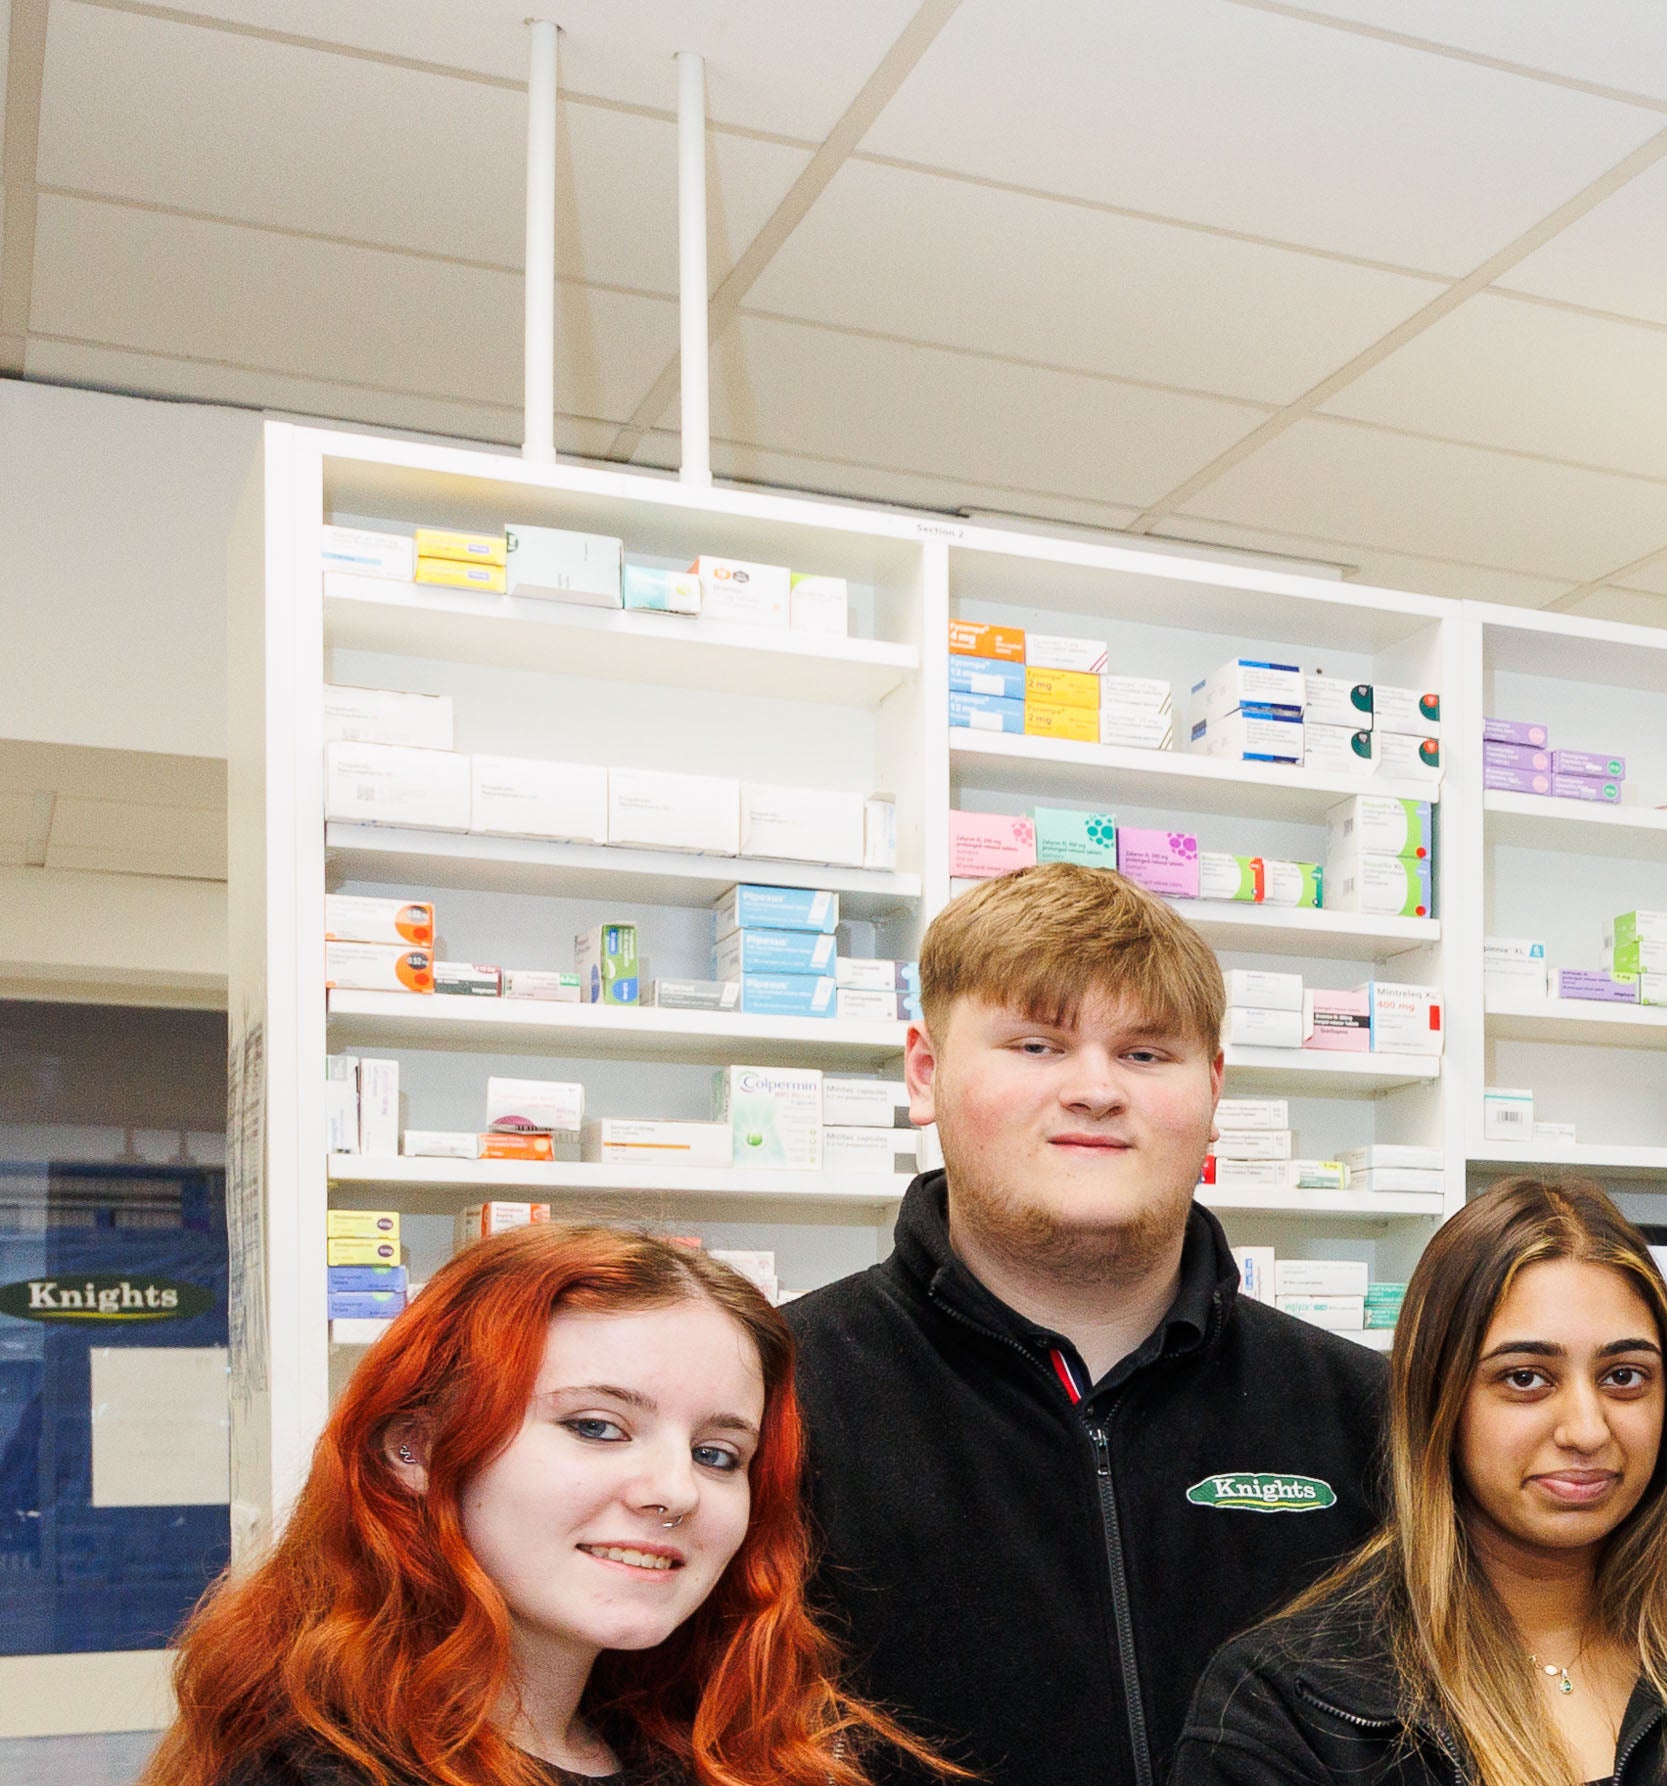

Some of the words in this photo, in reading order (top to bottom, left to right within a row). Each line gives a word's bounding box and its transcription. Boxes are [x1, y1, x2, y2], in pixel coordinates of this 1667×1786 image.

[917, 524, 955, 537] Section
[958, 530, 965, 538] 2
[1035, 682, 1052, 691] mg
[1035, 716, 1052, 725] mg
[1399, 1003, 1416, 1013] mg
[742, 1075, 817, 1094] Colpermin
[27, 1282, 178, 1312] Knights
[1212, 1478, 1316, 1502] Knights
